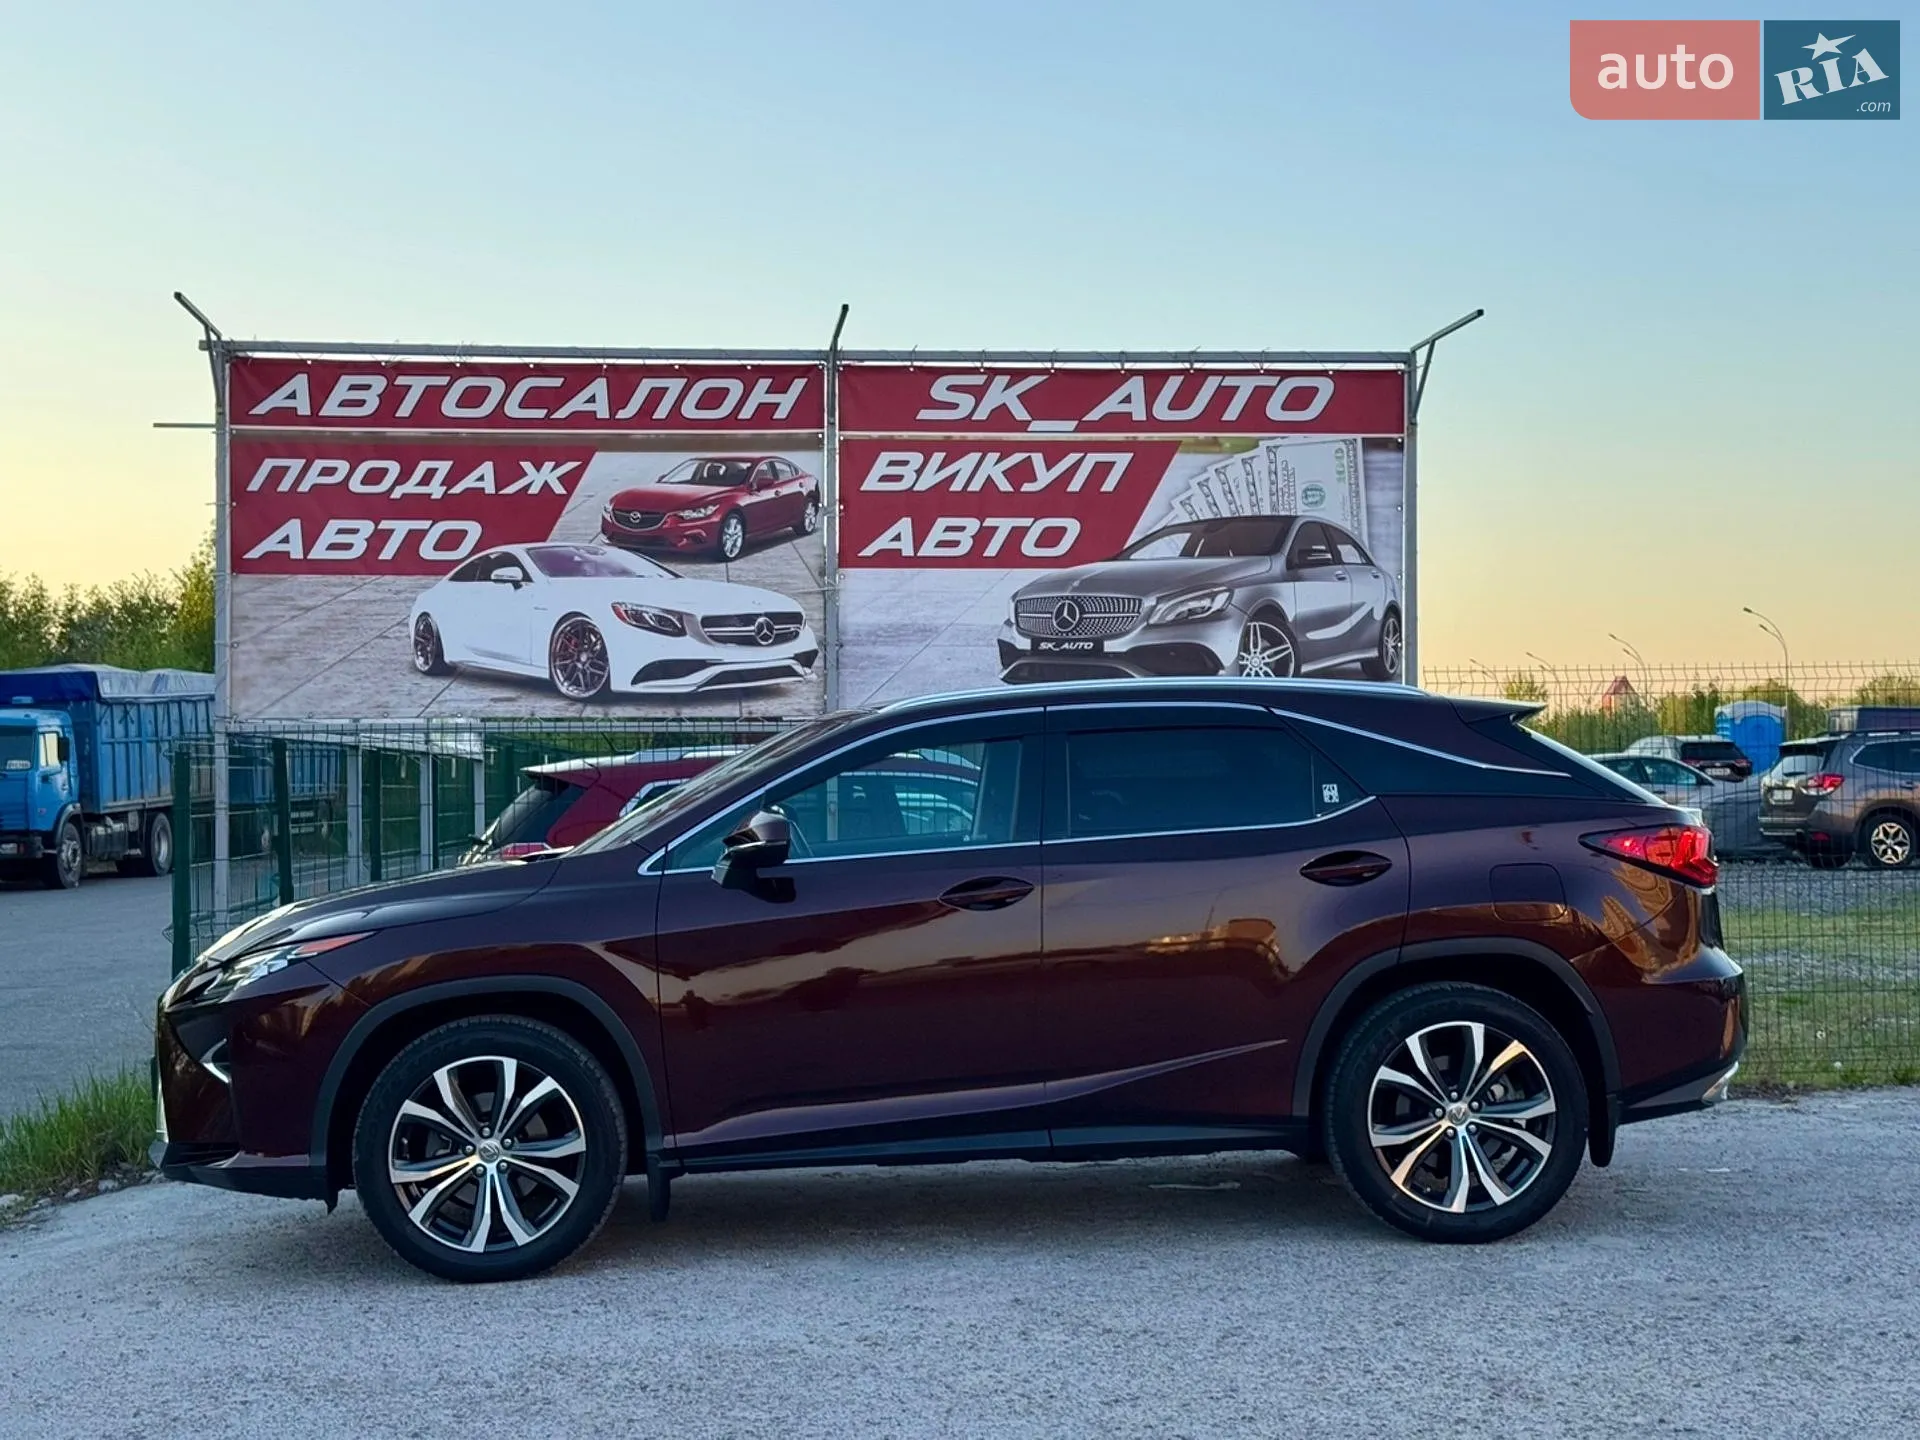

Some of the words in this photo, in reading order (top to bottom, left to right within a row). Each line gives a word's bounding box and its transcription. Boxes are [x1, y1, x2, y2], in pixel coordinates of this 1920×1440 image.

[248, 373, 808, 419] АВТОСАЛОН
[916, 374, 1335, 432] SK_AUTO
[246, 458, 582, 499] ПРОДАЖ
[860, 451, 1134, 492] ВИКУП
[243, 518, 483, 560] АВТО
[857, 517, 1081, 557] АВТО
[1038, 641, 1094, 651] SK_AUTO
